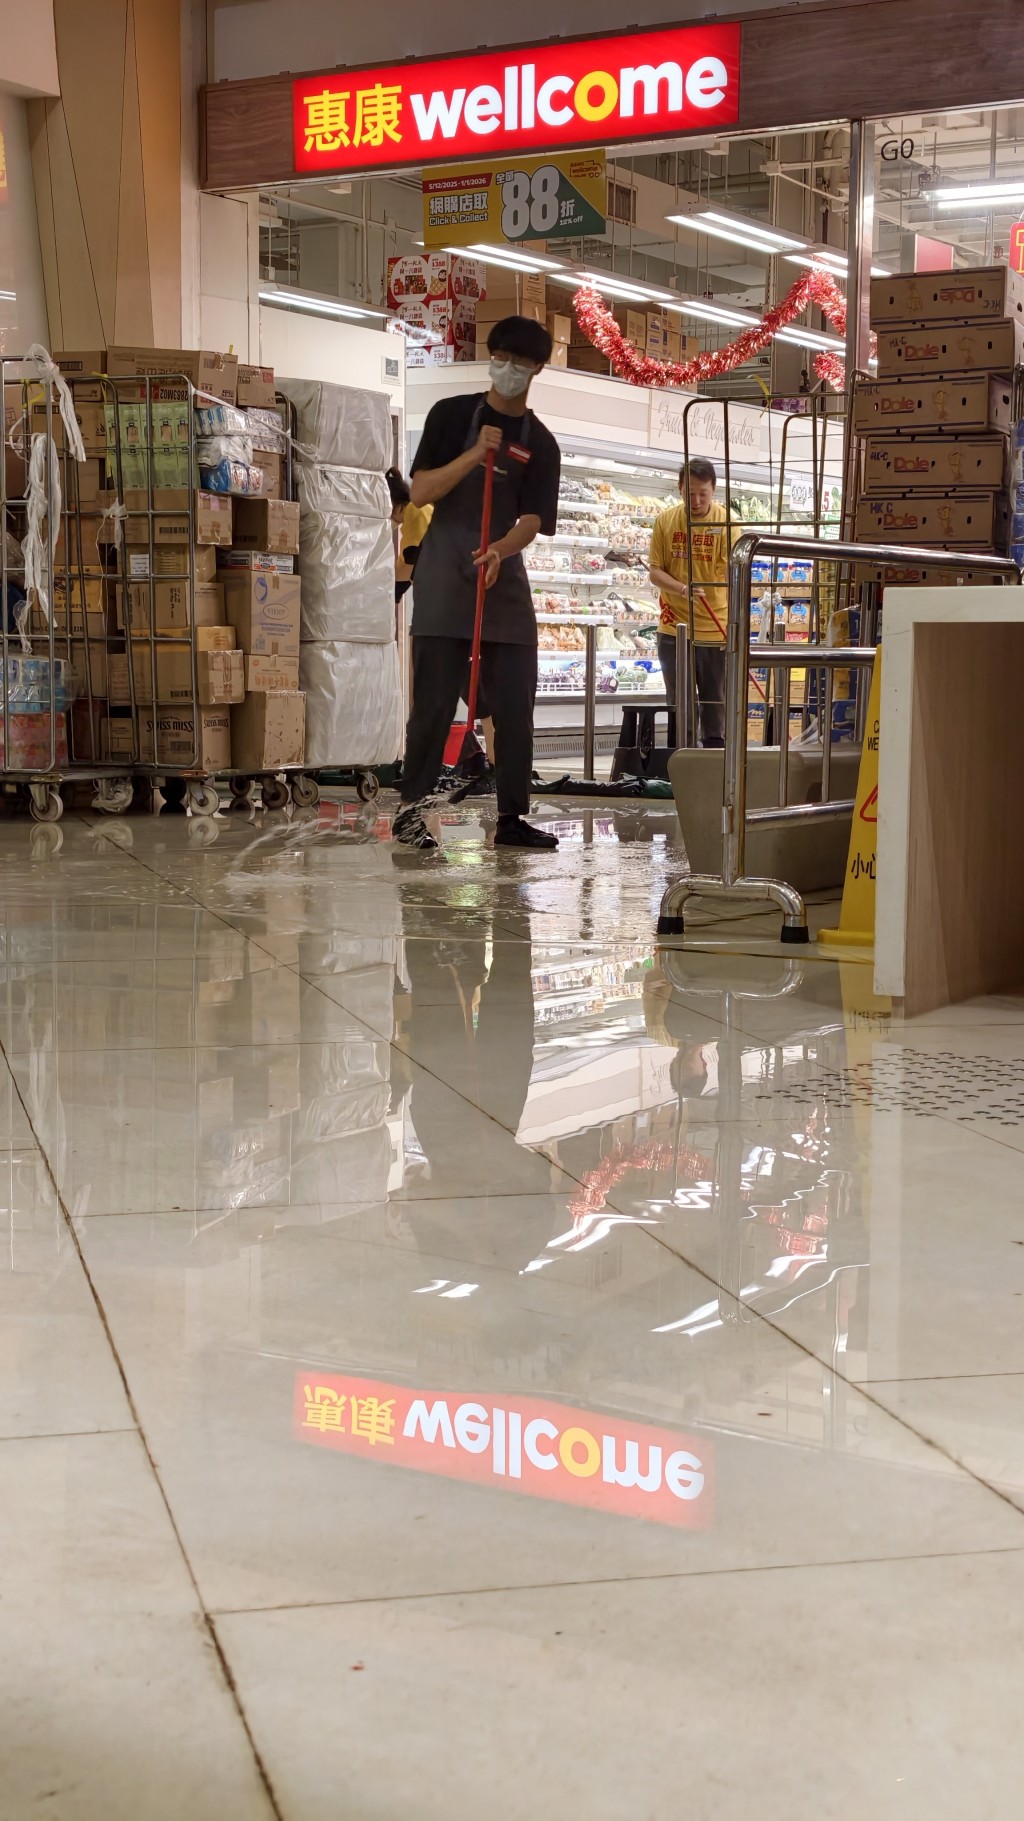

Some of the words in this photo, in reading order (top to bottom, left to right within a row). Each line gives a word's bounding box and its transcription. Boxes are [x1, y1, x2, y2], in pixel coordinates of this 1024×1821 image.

[303, 83, 403, 153] 惠康
[410, 56, 728, 141] wellcome
[428, 180, 458, 190] 5/12/2025
[461, 178, 487, 187] 1/1/2026
[429, 191, 488, 215] 網購店取
[502, 165, 560, 238] 88
[560, 199, 575, 218] 折
[429, 216, 449, 226] Click
[451, 214, 458, 224] &
[459, 211, 488, 222] Collect
[573, 215, 584, 223] off
[940, 288, 976, 304] Dole
[904, 342, 940, 358] Dole
[881, 396, 915, 411] Dole
[894, 455, 929, 470] Dole
[870, 502, 883, 514] HK
[883, 511, 918, 527] Dole
[672, 531, 714, 547] 網店取
[884, 566, 920, 581] Dole
